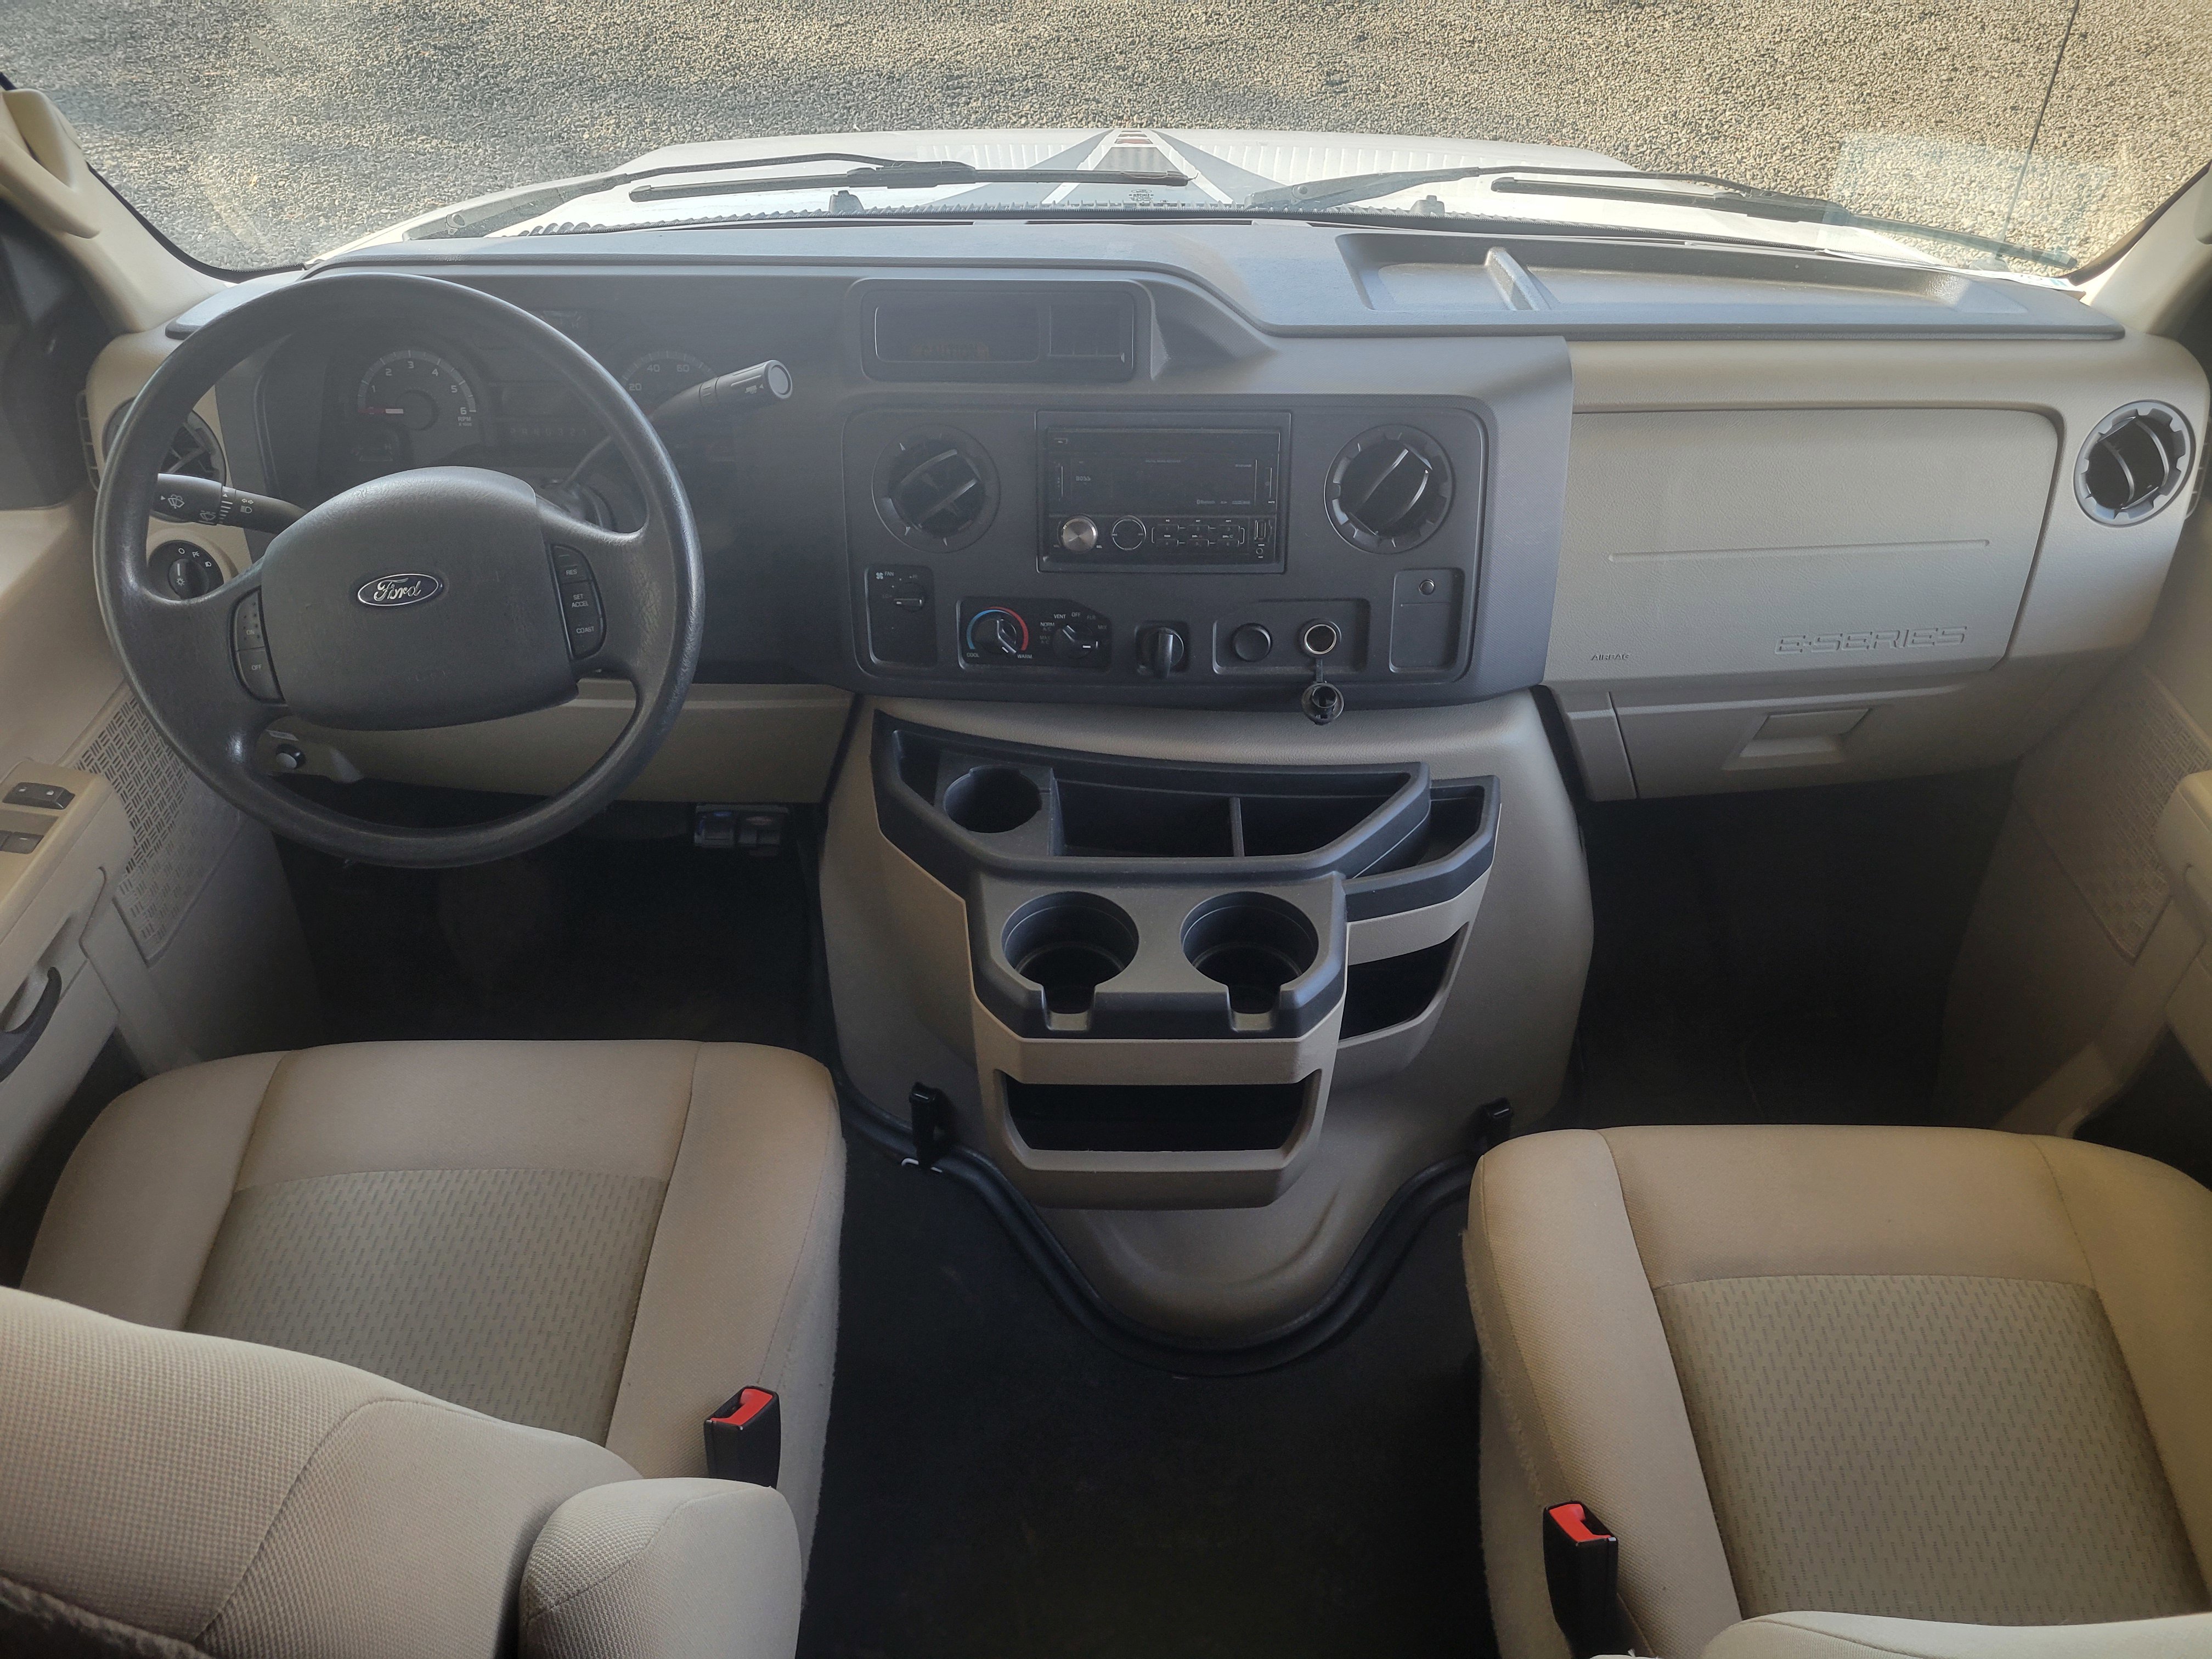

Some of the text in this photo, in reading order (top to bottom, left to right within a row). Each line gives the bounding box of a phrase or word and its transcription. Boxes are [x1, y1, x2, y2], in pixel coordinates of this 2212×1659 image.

[432, 368, 439, 376] 4
[647, 364, 661, 373] 40
[676, 364, 690, 373] 60
[371, 385, 376, 393] 1
[374, 578, 421, 601] Ford
[1775, 626, 1968, 655] E-SERIES
